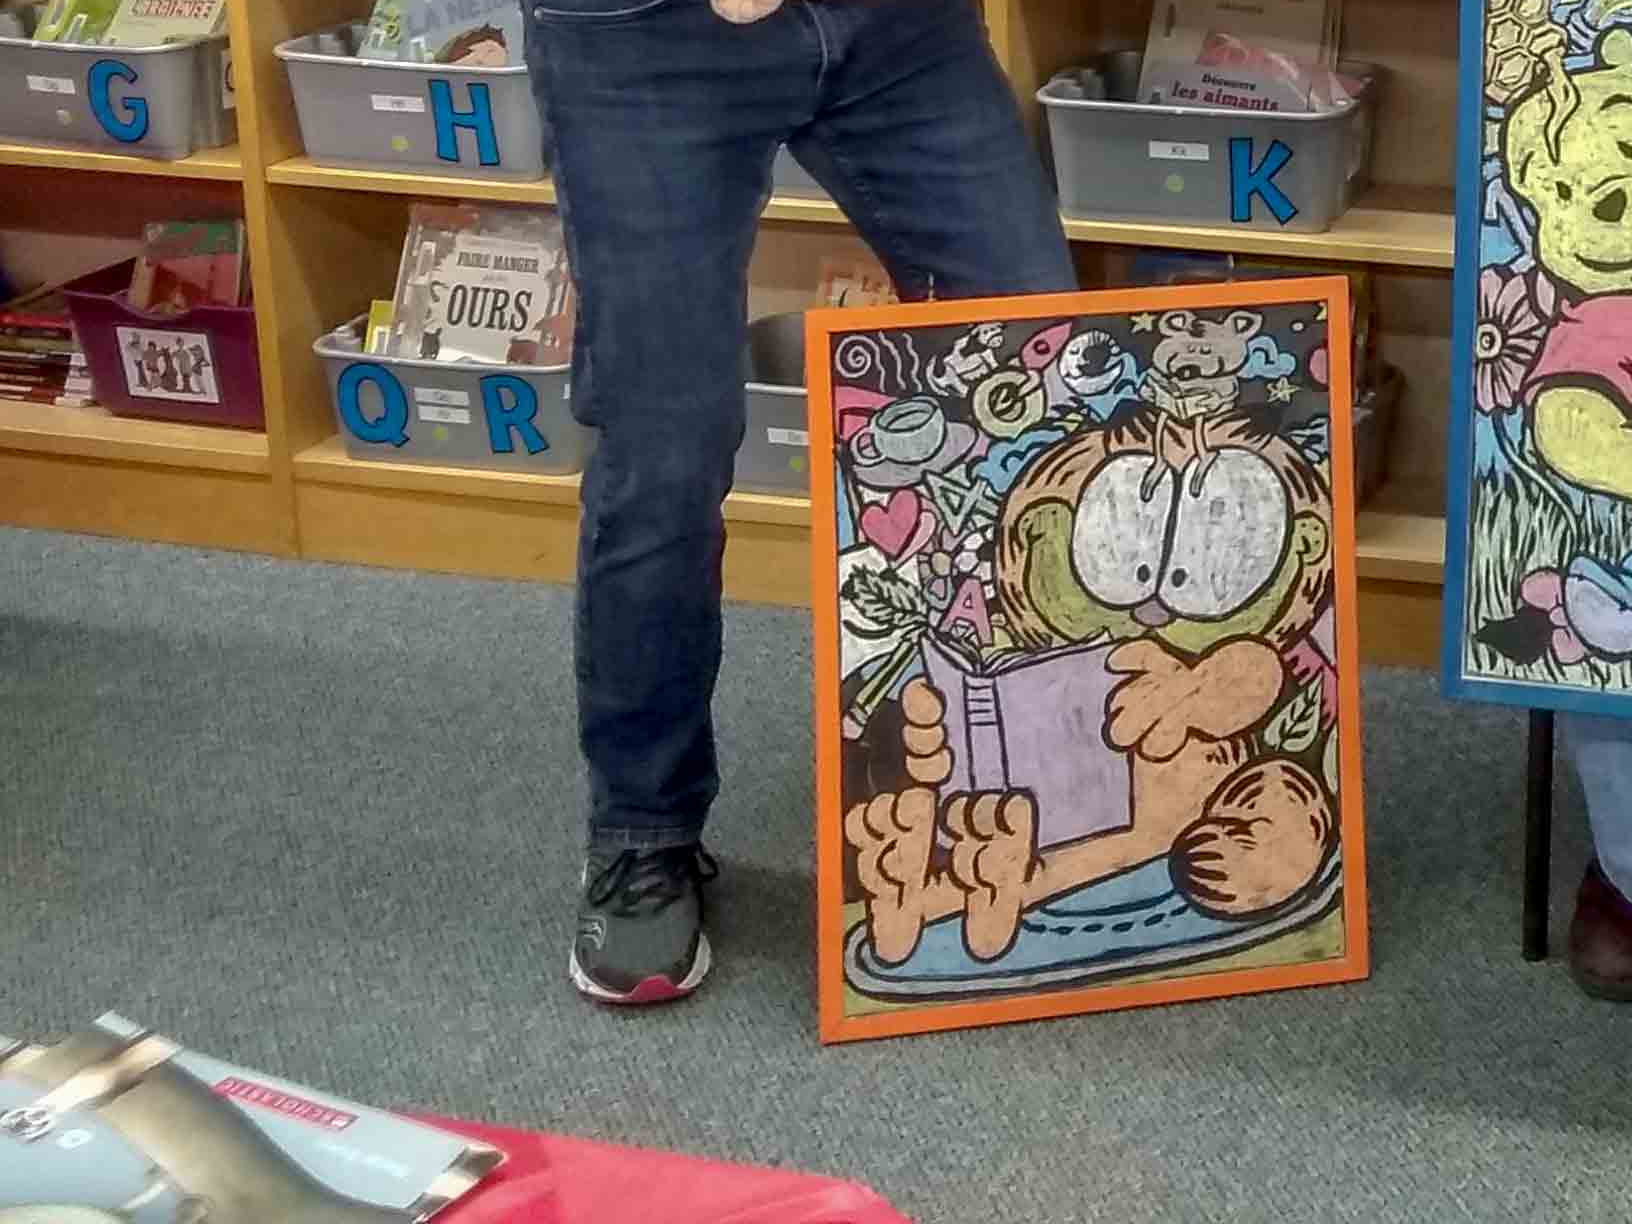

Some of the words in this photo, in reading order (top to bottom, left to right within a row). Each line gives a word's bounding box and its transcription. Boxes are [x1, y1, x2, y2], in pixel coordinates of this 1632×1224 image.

[87, 58, 150, 144] G
[427, 78, 501, 167] H
[1171, 80, 1199, 101] les
[1203, 90, 1280, 112] aimants
[1228, 137, 1299, 226] K
[493, 256, 540, 274] MANGER
[446, 284, 534, 333] OURS
[337, 362, 411, 449] Q
[479, 375, 551, 456] R
